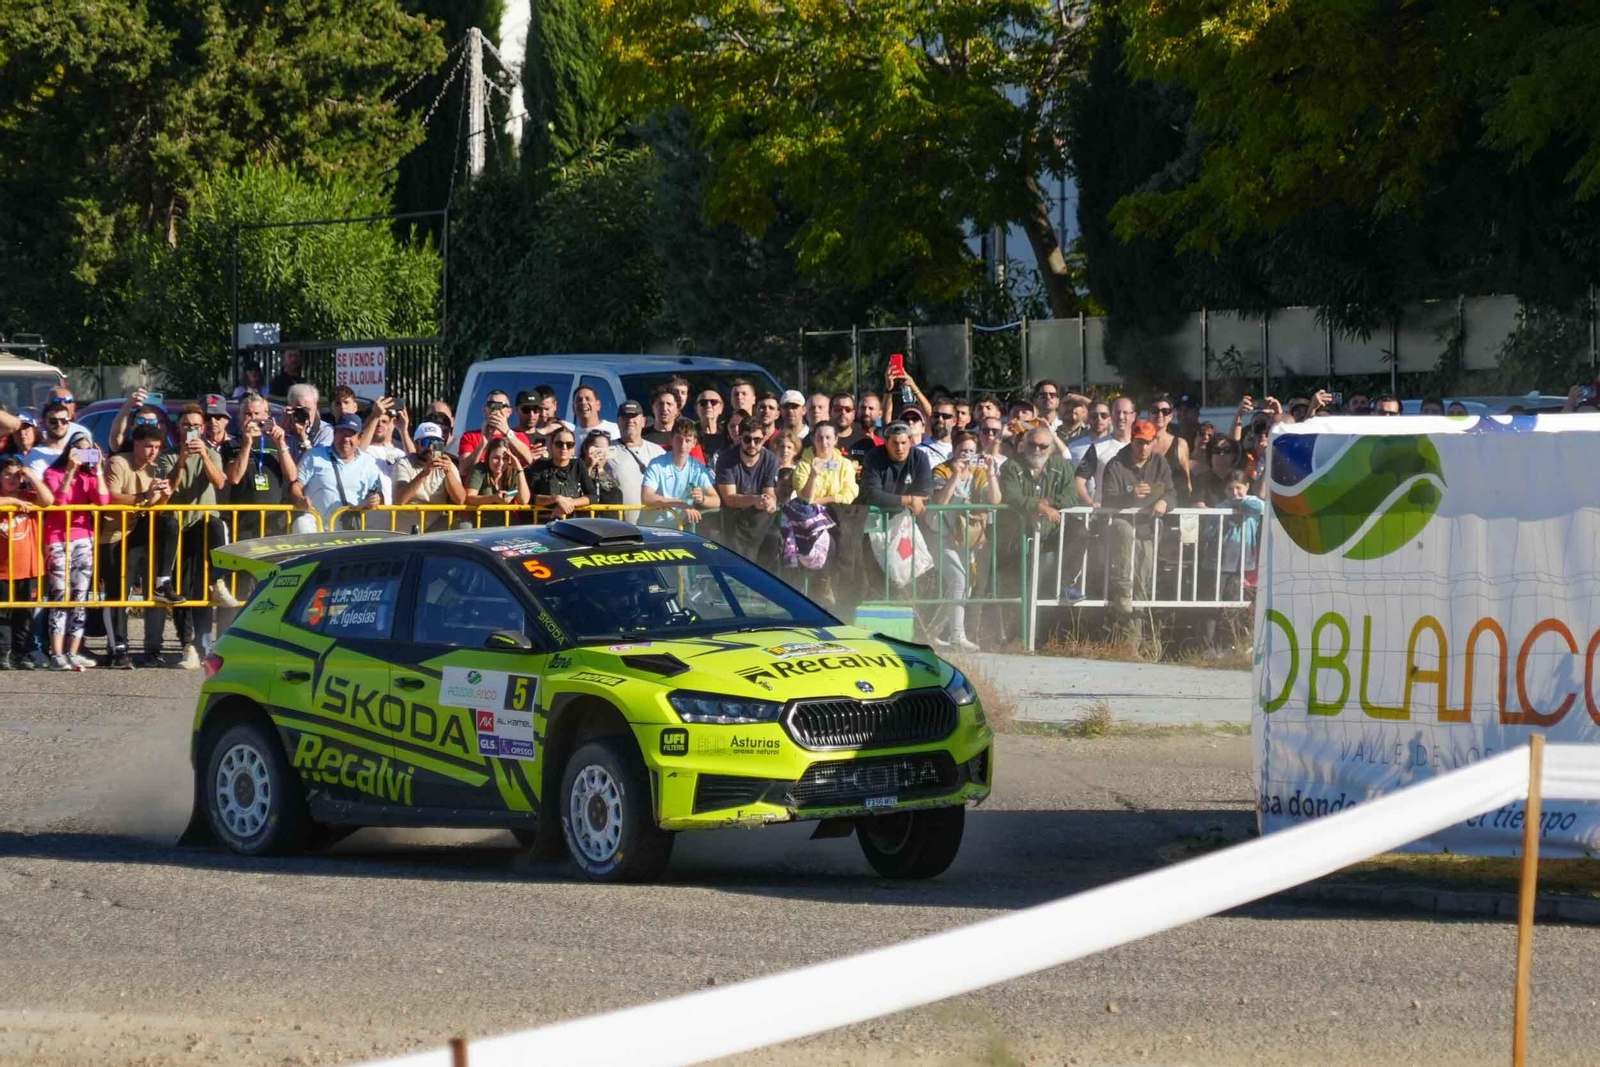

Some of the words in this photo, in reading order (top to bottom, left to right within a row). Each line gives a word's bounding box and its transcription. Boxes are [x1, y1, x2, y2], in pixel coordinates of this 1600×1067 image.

[337, 353, 347, 368] SE
[350, 352, 374, 367] VENDE
[337, 371, 347, 385] SE
[350, 370, 383, 386] ALQUILA
[592, 549, 675, 567] Recalvi
[522, 559, 552, 579] 5
[275, 576, 299, 586] MOTUL
[351, 587, 383, 602] Suárez
[309, 588, 327, 626] 5
[329, 613, 339, 625] A.
[341, 609, 376, 627] Iglesias
[771, 653, 900, 679] Recalvi
[512, 678, 528, 710] 5
[663, 733, 686, 745] UFI
[663, 744, 685, 752] FILTERS
[730, 734, 780, 749] Asturias
[1341, 740, 1403, 766] VALLE
[1416, 744, 1441, 768] DE
[293, 733, 415, 806] Recalvi
